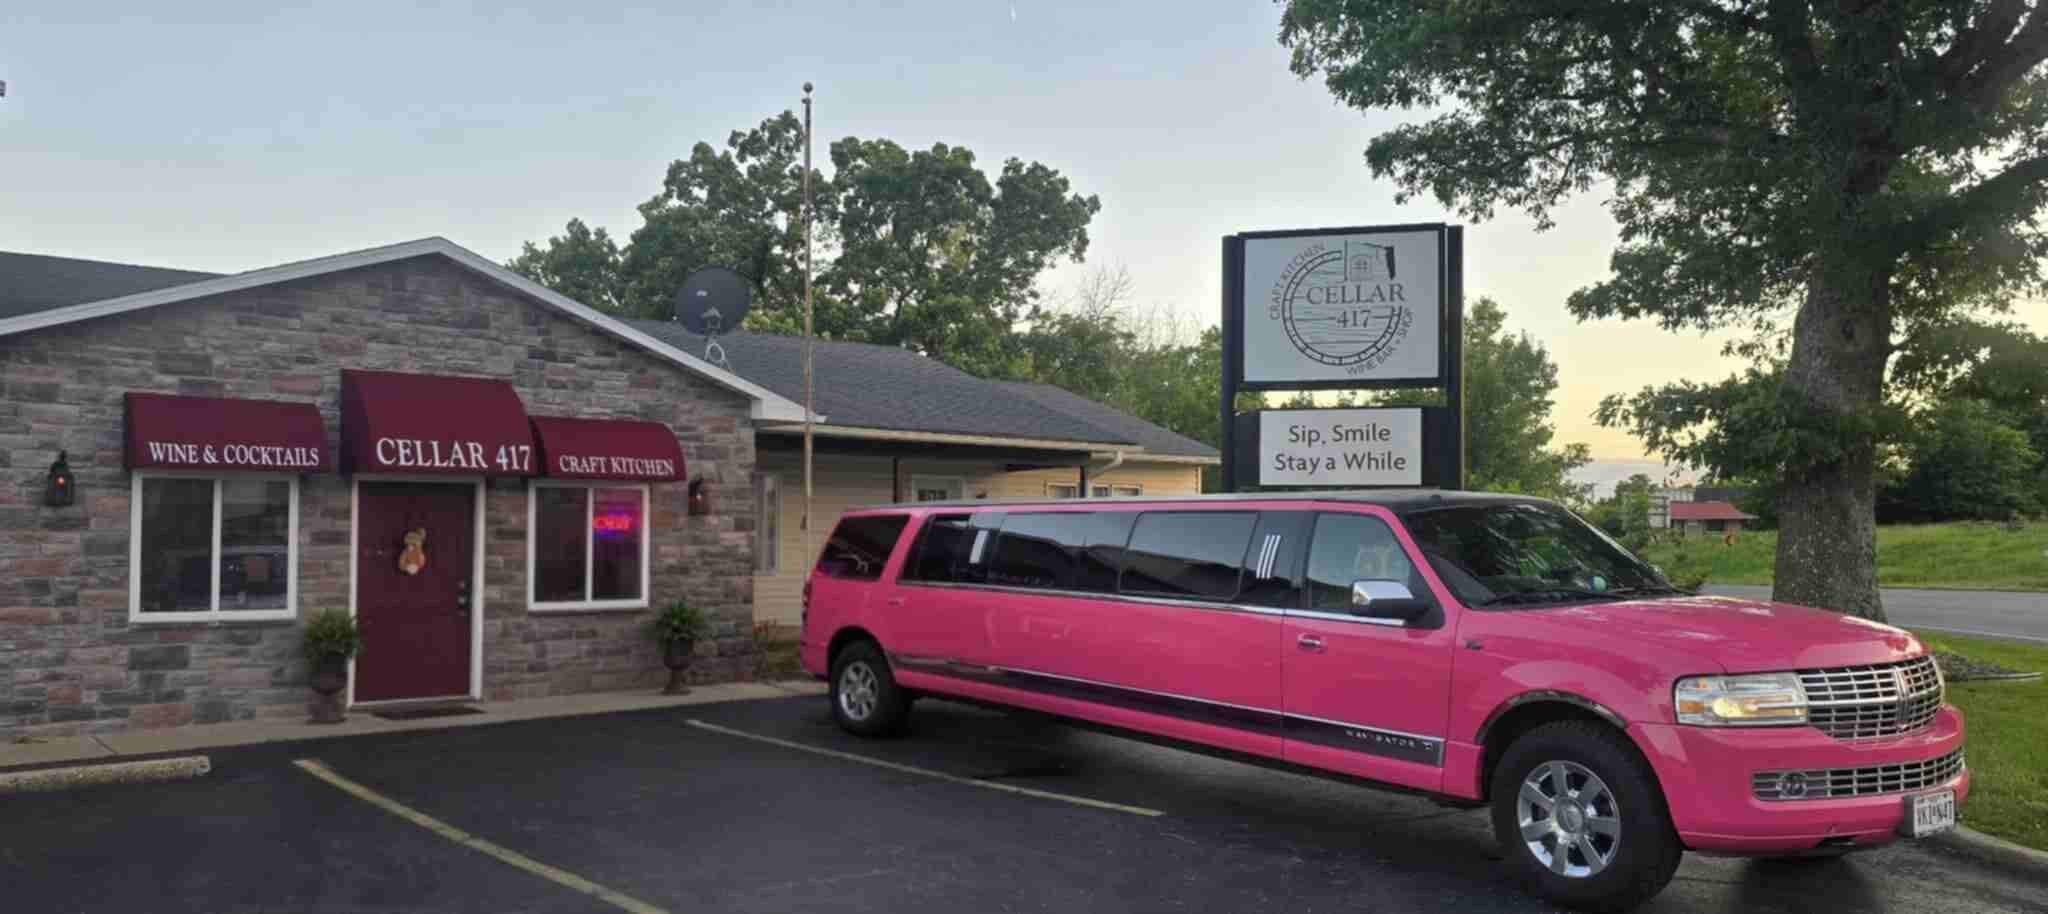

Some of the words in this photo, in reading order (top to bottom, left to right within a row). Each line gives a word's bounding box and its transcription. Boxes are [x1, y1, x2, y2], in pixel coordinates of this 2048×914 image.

[1270, 280, 1283, 321] CRAFT
[1280, 243, 1326, 281] KITCHEN
[1306, 283, 1405, 305] CELLAR
[1336, 309, 1371, 329] 417
[1345, 358, 1378, 377] WINE
[1376, 344, 1398, 365] BAR
[1397, 307, 1415, 339] SHOP
[1288, 424, 1327, 447] Sip,
[1332, 422, 1391, 443] Smile
[148, 441, 199, 464] WINE
[203, 444, 219, 464] &
[223, 444, 320, 467] COCKTAILS
[376, 437, 489, 469] CELLAR
[495, 444, 531, 472] 417
[559, 454, 608, 474] CRAFT
[610, 456, 675, 476] KITCHEN
[1274, 453, 1321, 475] Stay
[1325, 457, 1336, 471] a
[1344, 452, 1407, 471] While
